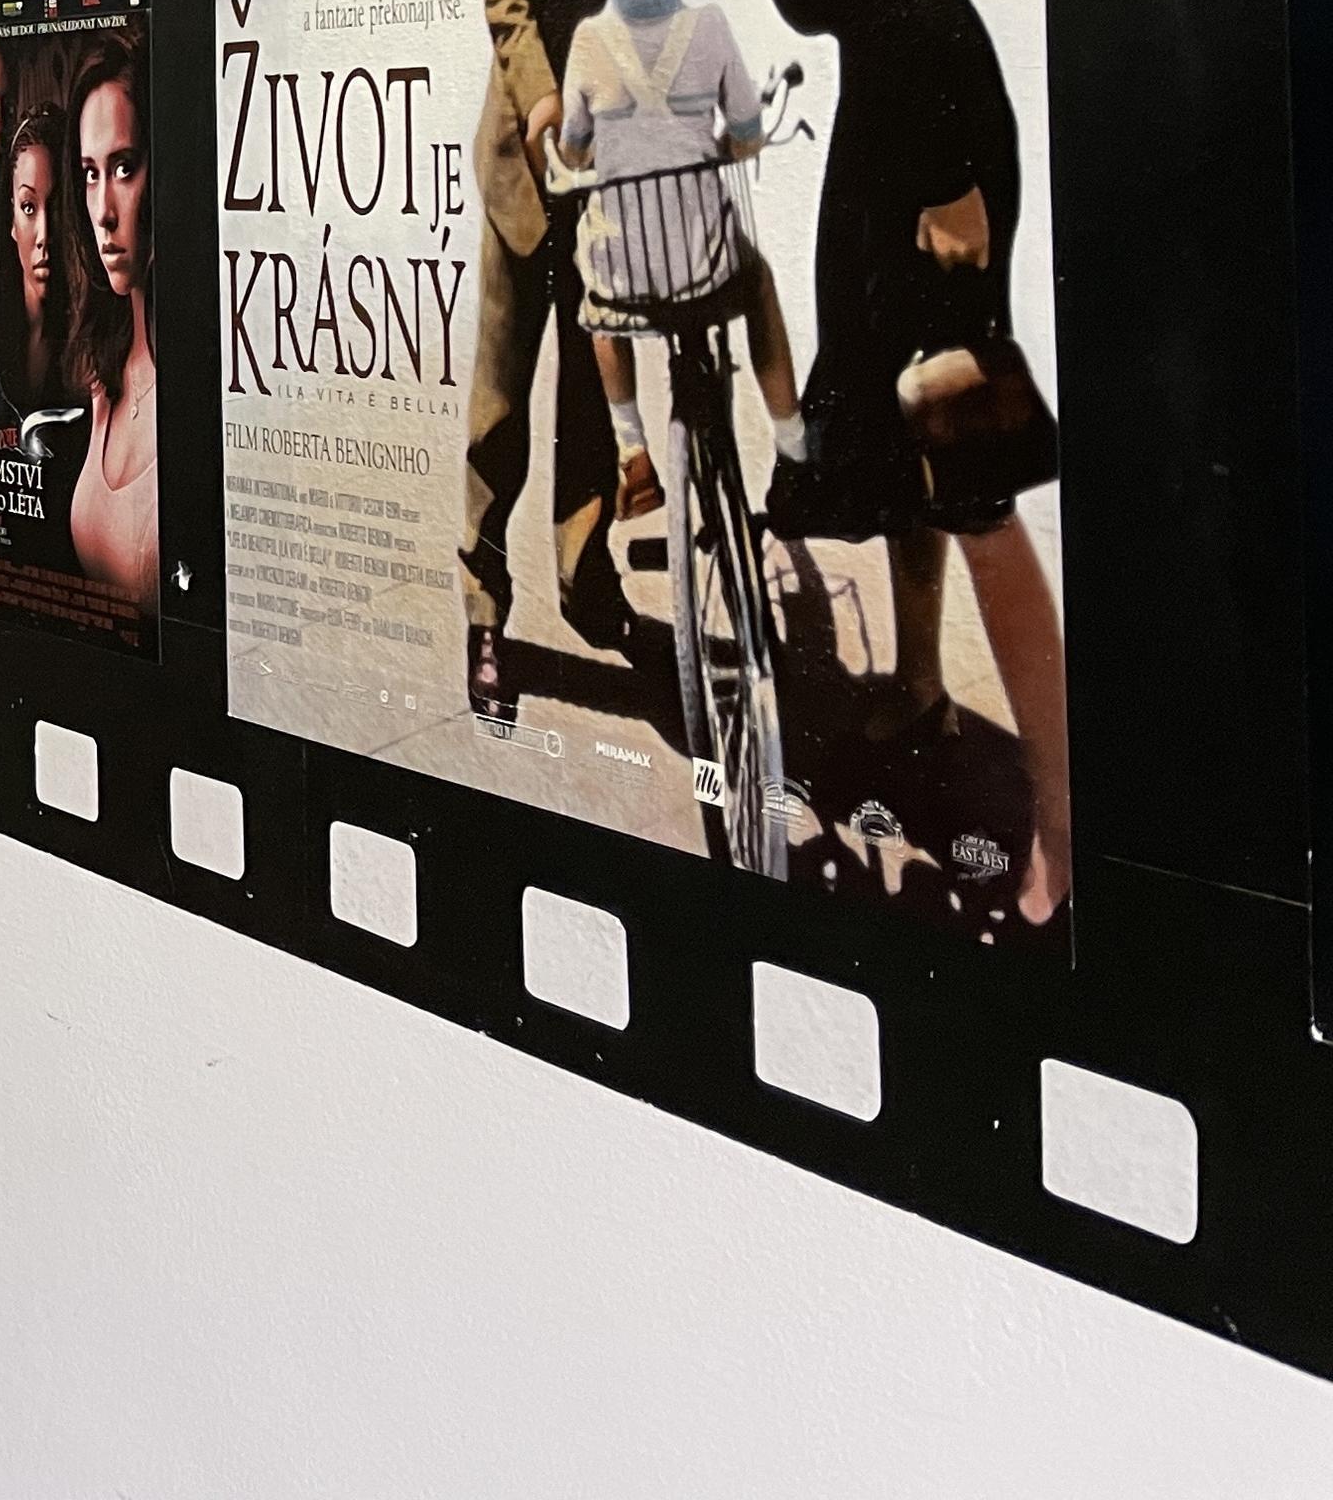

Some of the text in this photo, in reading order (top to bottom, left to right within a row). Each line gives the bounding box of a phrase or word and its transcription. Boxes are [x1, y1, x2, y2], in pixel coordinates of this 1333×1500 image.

[303, 10, 311, 31] a
[430, 143, 465, 234] JE
[223, 223, 467, 396] KRÁSNÝ
[277, 384, 304, 399] (LA
[317, 387, 355, 405] VITA
[390, 396, 460, 419] BELLA)
[225, 421, 431, 476] FILM ROBERTA BENIGNIHO
[8, 488, 45, 520] LÉTA
[594, 740, 652, 769] MIRAMAX
[694, 764, 724, 801] illy
[951, 841, 1010, 872] EAST-WEST
